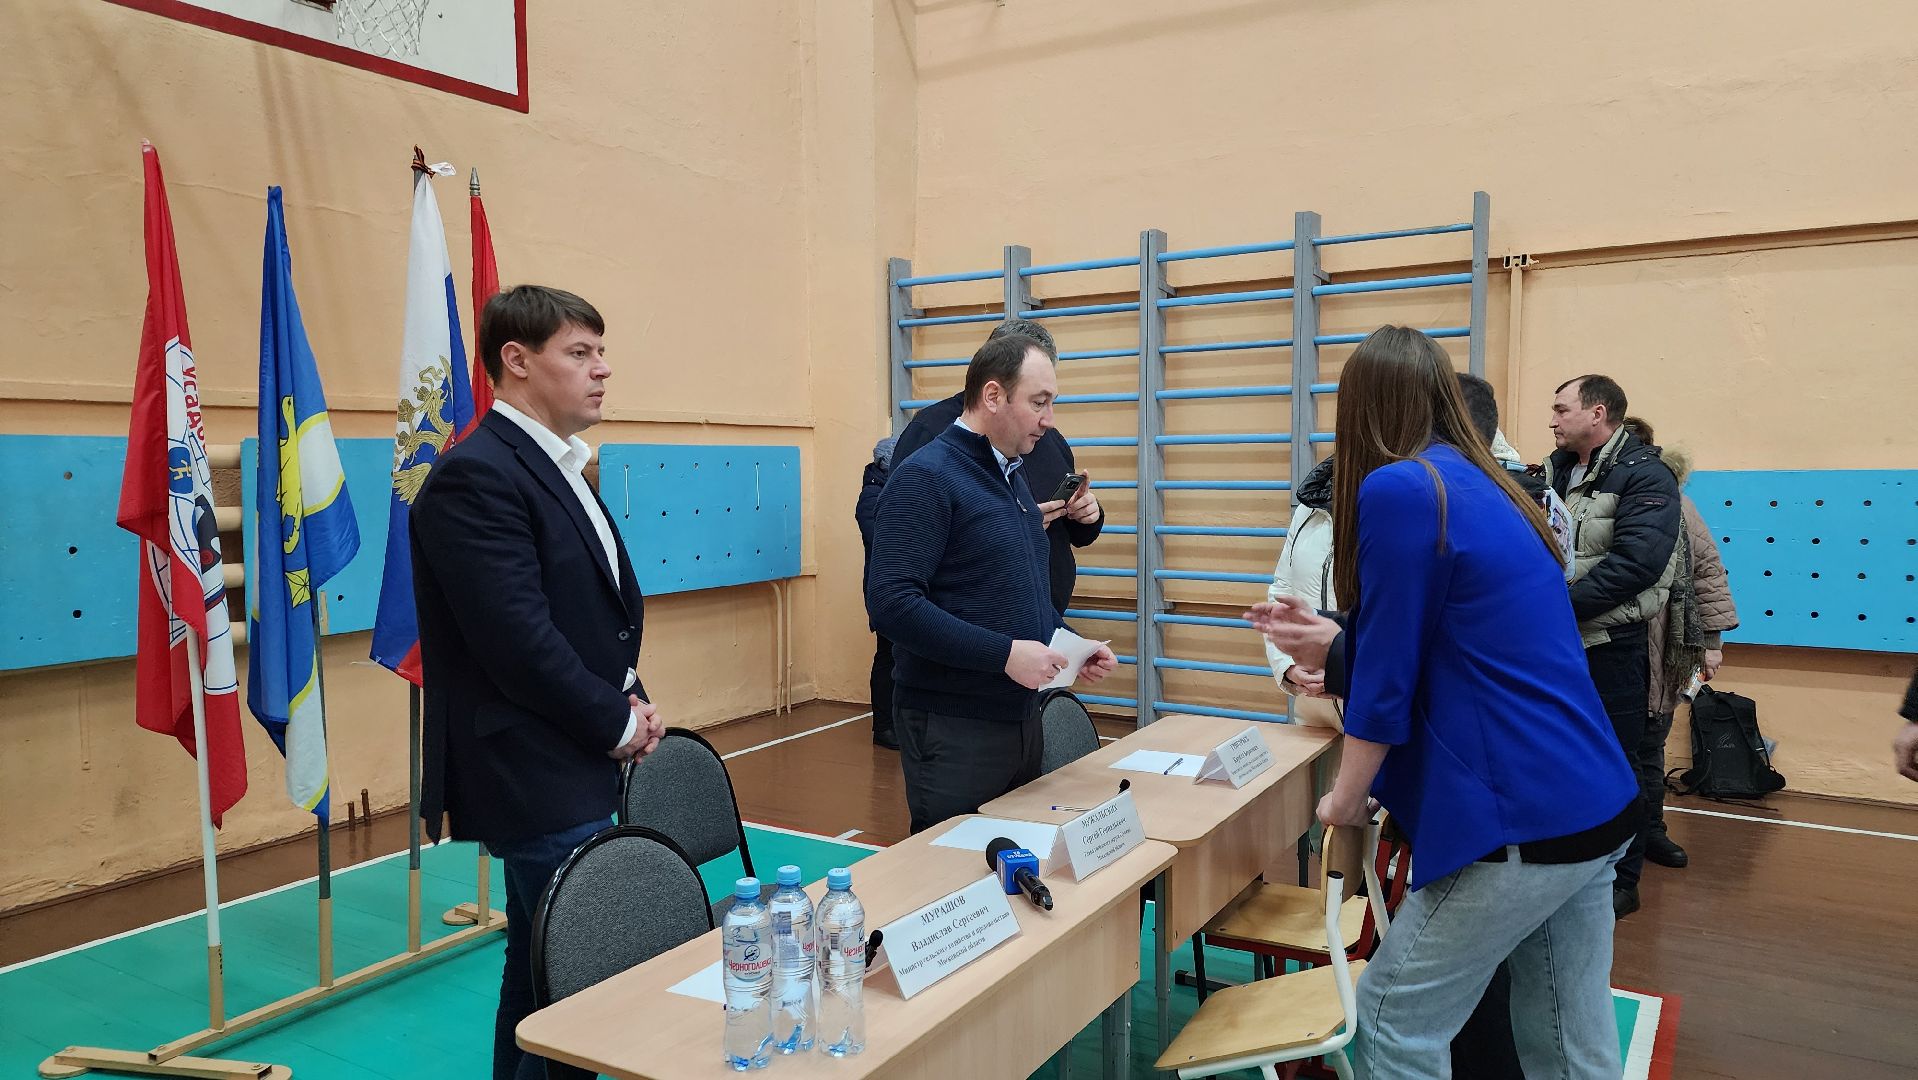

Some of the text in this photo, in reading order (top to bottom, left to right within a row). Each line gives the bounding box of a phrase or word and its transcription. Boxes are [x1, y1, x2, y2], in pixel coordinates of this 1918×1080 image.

[910, 904, 990, 953] Владислав Сергеевич
[920, 894, 966, 926] МУРАШОВ
